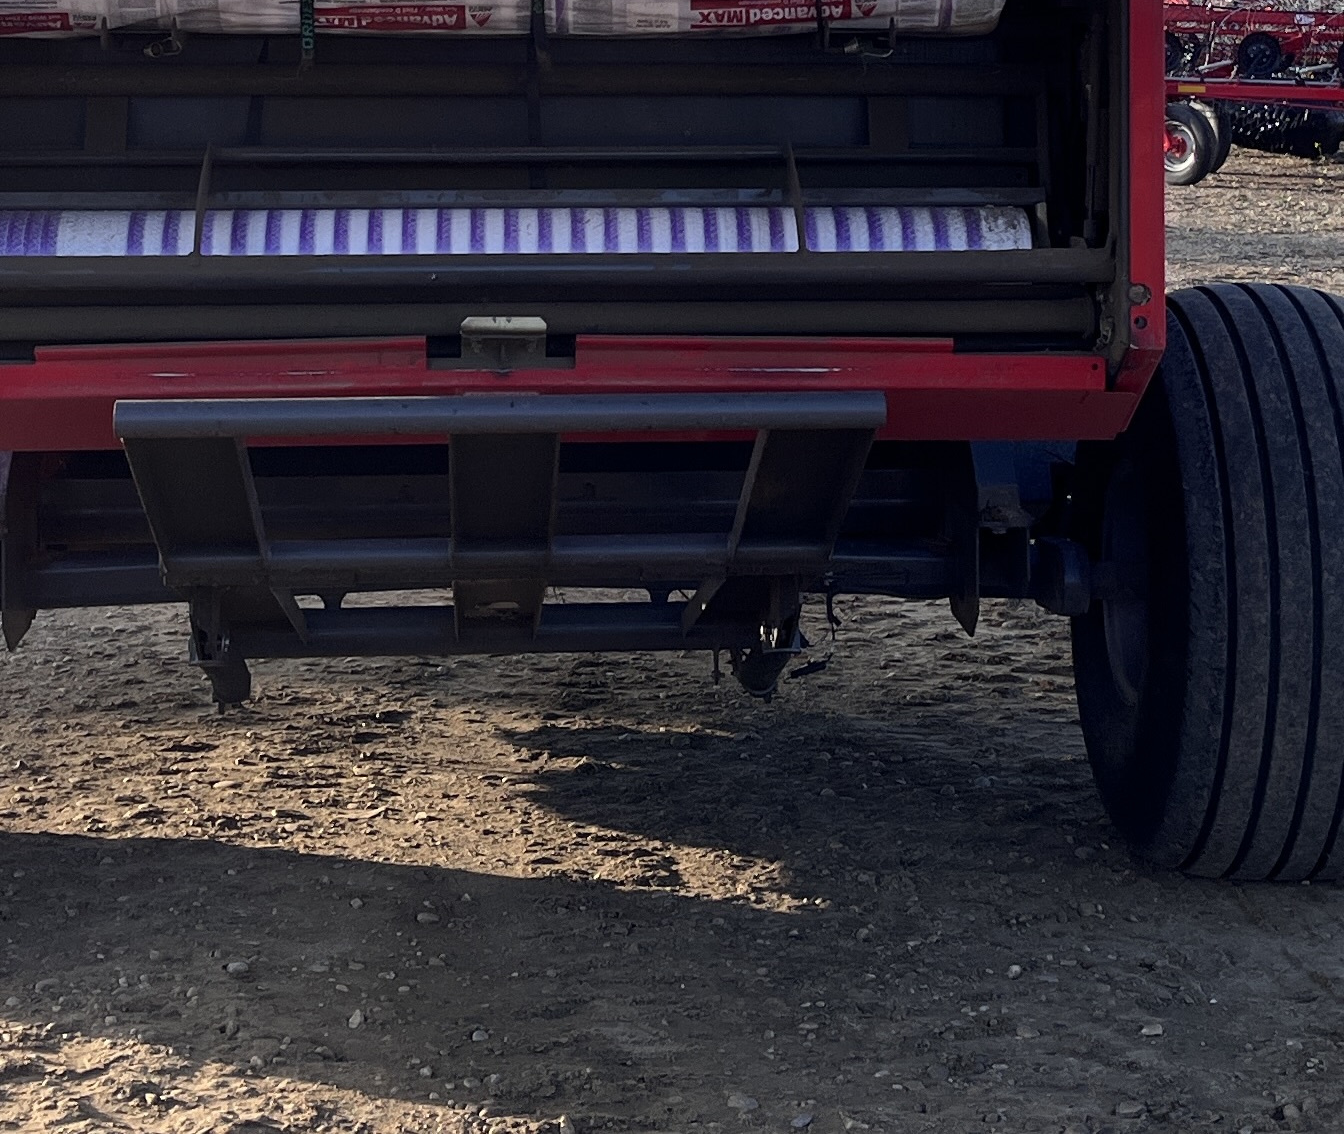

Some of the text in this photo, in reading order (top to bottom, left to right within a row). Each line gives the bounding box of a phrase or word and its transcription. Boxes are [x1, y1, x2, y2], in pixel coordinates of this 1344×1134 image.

[361, 13, 458, 27] Advanced
[698, 4, 844, 24] Advanced MAX
